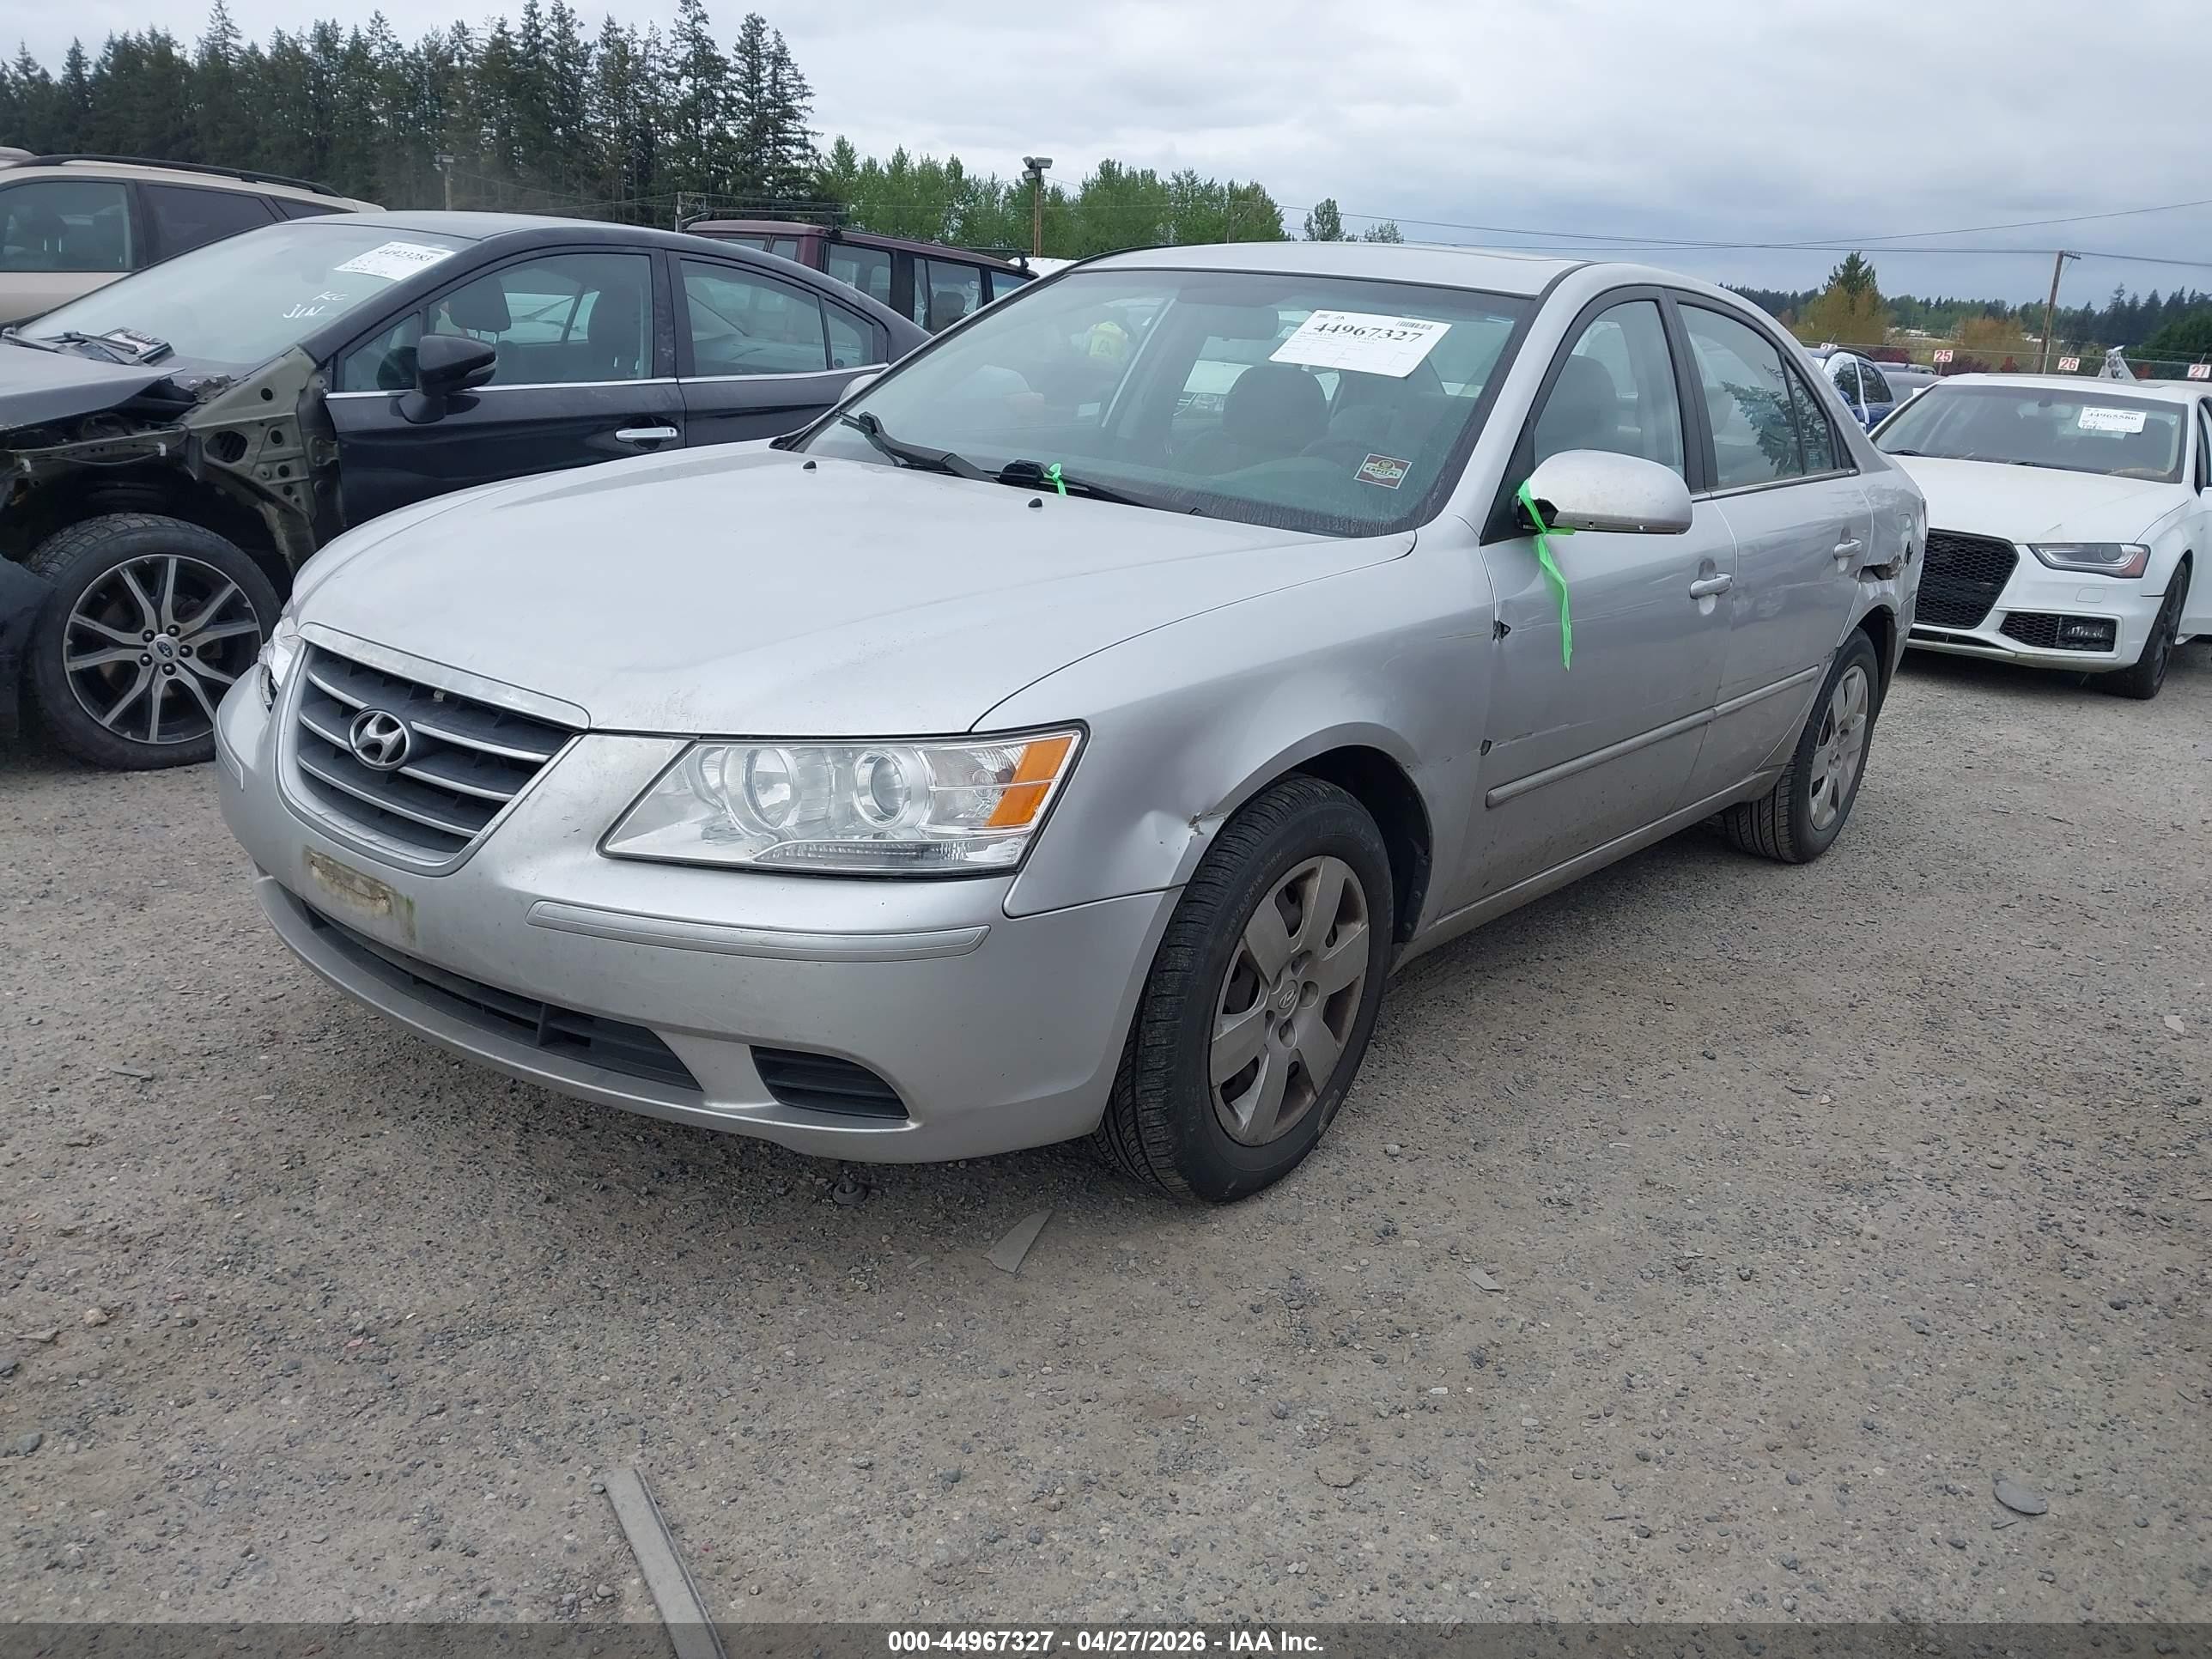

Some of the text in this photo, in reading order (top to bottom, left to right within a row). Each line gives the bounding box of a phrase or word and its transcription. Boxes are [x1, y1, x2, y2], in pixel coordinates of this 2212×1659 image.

[1313, 321, 1423, 343] 44967327
[1935, 350, 1952, 362] 25
[2059, 357, 2077, 370] 26
[2191, 365, 2209, 378] 27
